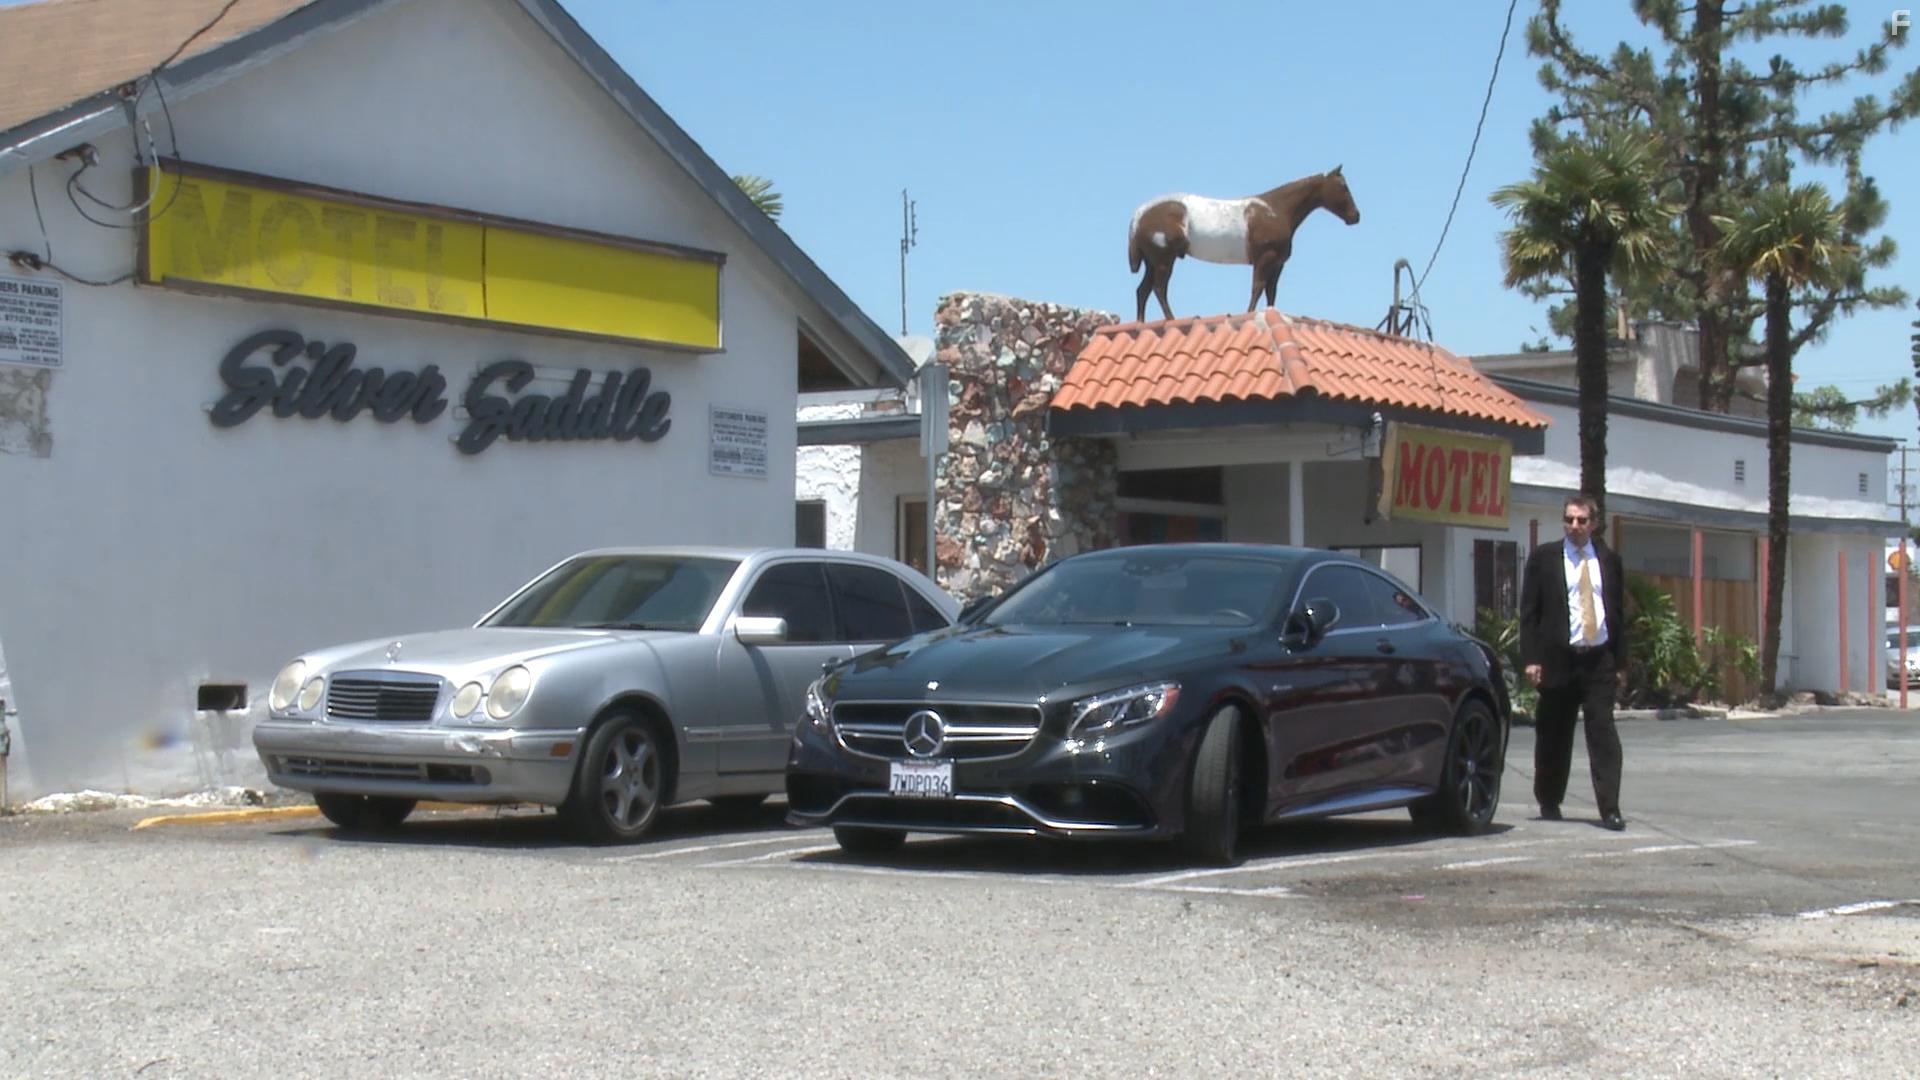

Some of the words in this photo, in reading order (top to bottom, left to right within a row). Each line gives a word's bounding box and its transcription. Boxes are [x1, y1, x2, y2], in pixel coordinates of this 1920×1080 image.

[170, 181, 469, 311] MOTEL
[22, 283, 59, 298] PARKING
[210, 329, 448, 427] Silver
[455, 359, 671, 455] Saddle
[1395, 441, 1505, 518] MOTEL
[892, 773, 949, 793] 7WDP036
